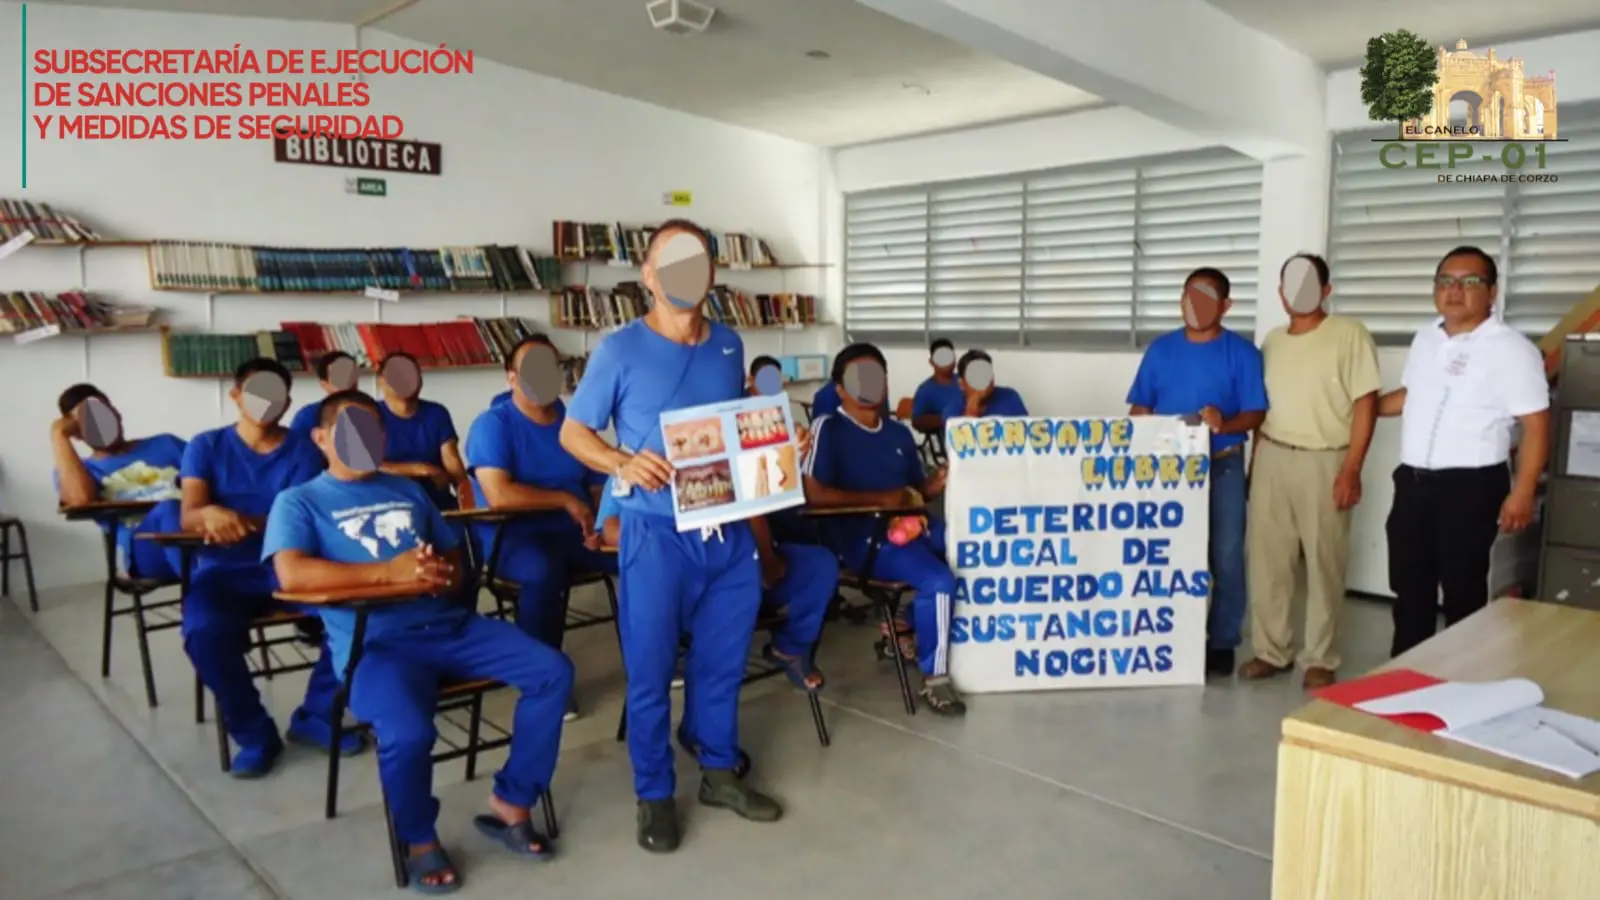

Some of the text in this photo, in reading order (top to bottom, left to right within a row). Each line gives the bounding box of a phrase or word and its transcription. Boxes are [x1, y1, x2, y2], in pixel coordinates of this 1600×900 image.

[285, 135, 431, 171] BIBLIOTECA
[949, 418, 1134, 459] MENSAJE
[1081, 453, 1210, 491] LIBRE
[968, 501, 1184, 536] DETERIORO
[956, 538, 1171, 569] BUCAL DE
[954, 571, 1123, 605] ACUERDO
[951, 606, 1175, 644] SUSTANCIAS
[1014, 645, 1173, 677] NOCIVAS
